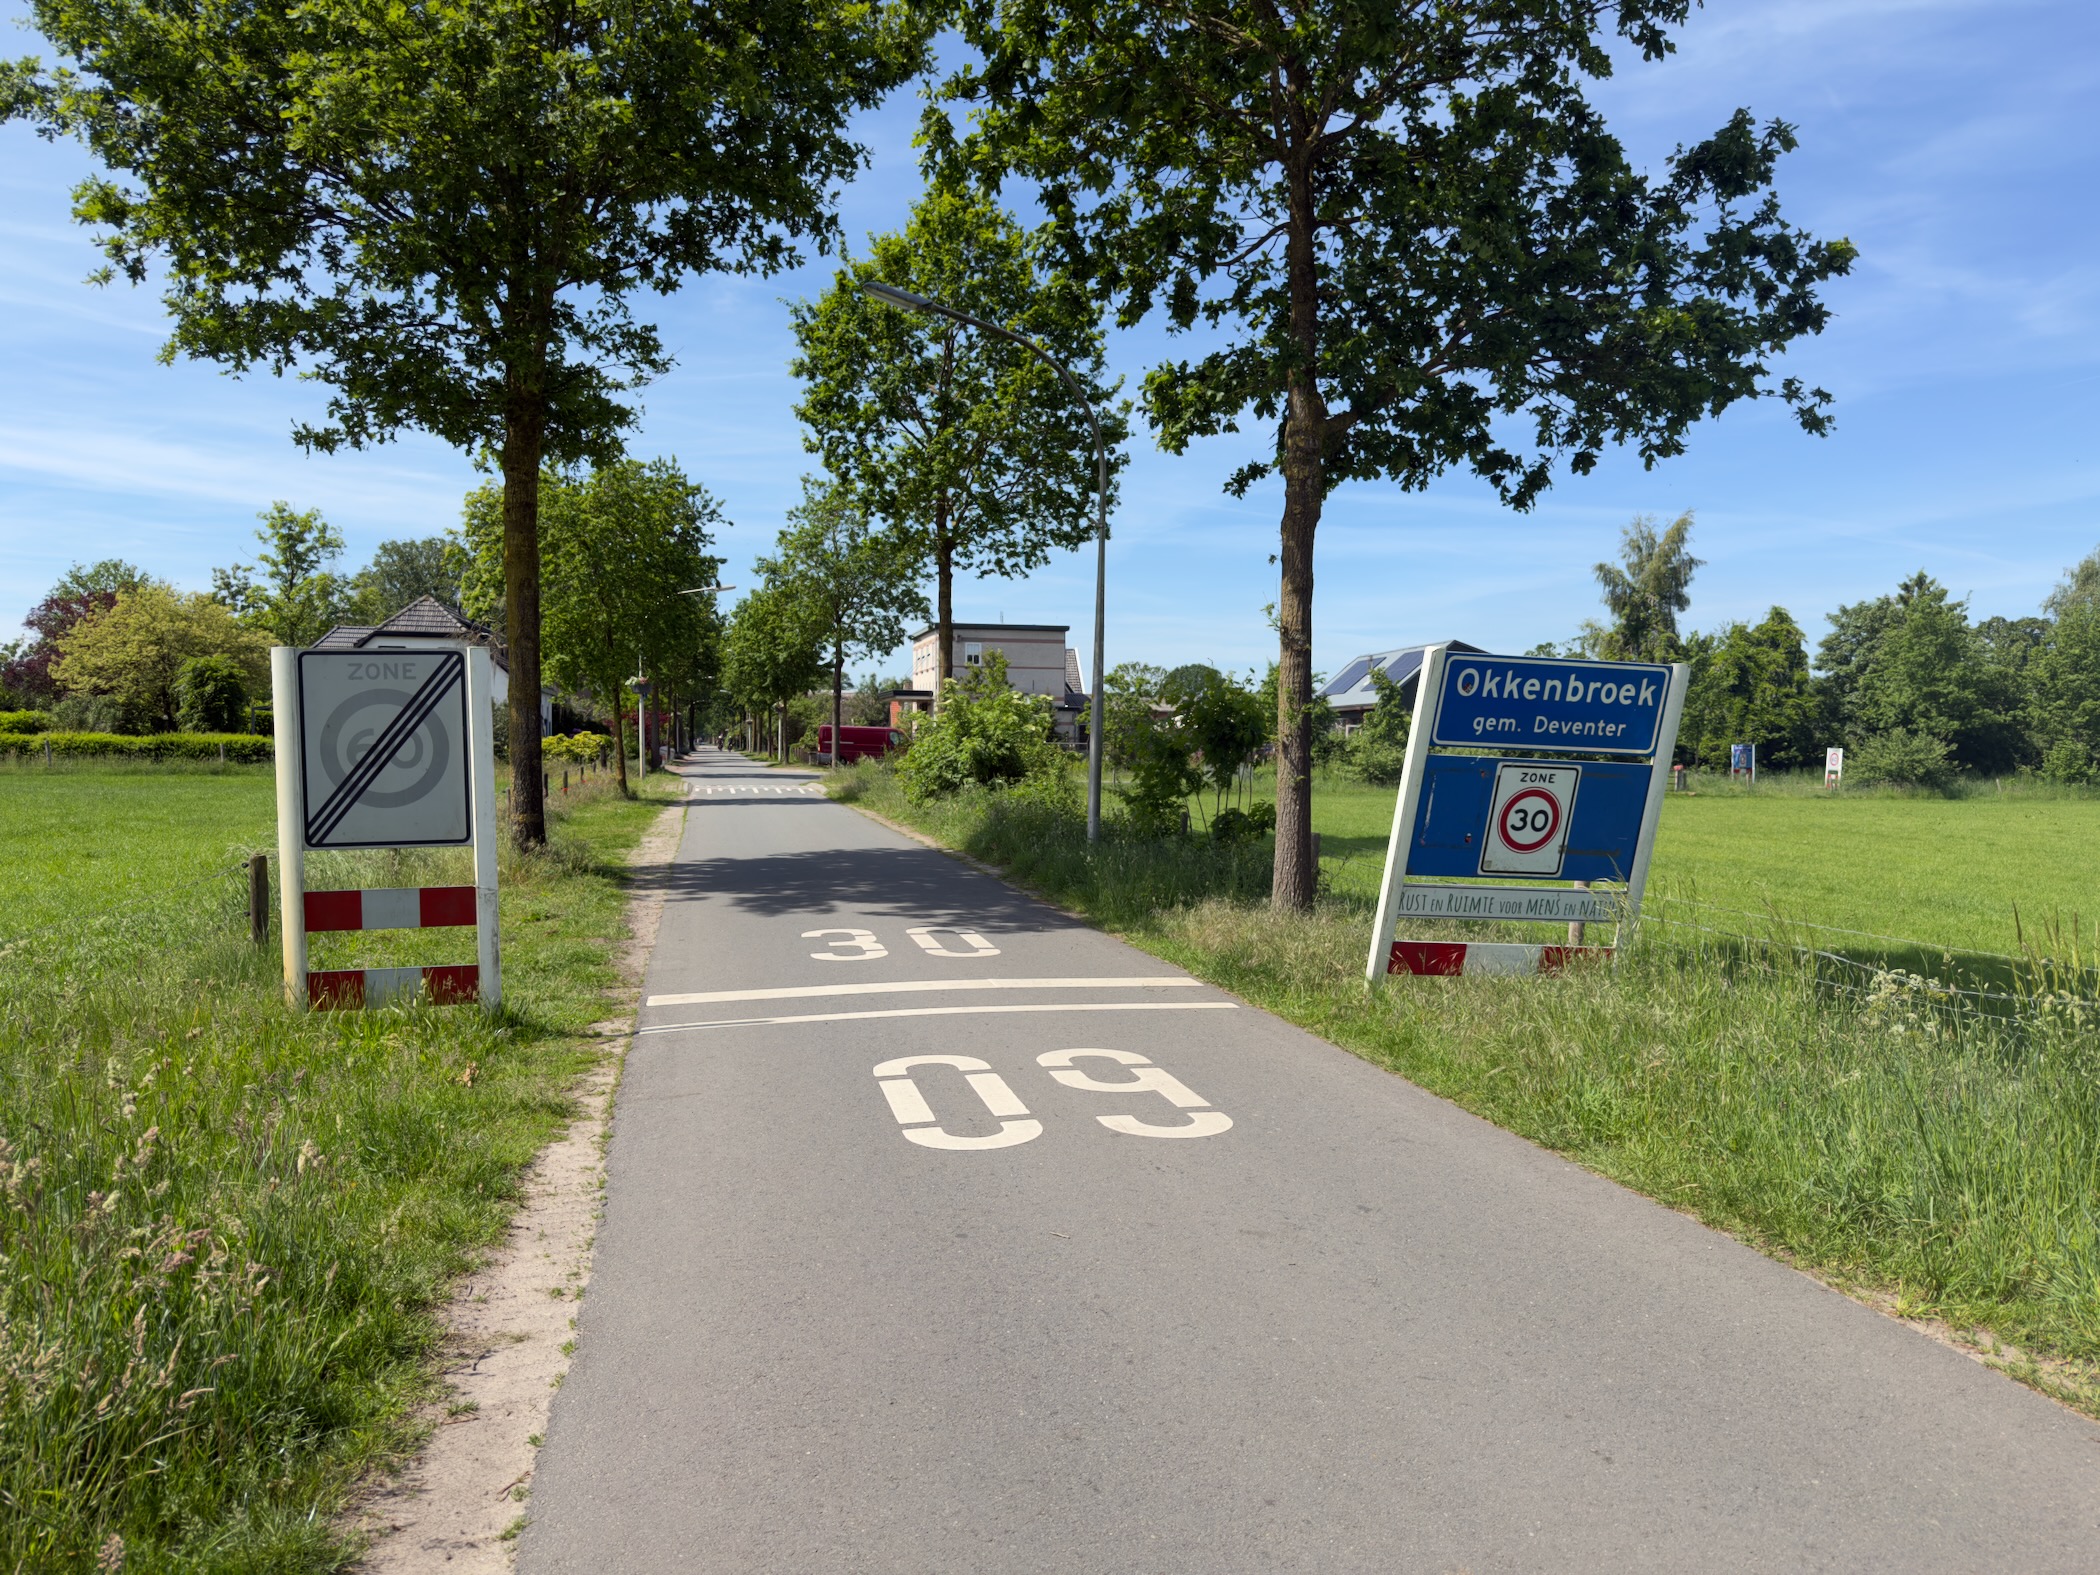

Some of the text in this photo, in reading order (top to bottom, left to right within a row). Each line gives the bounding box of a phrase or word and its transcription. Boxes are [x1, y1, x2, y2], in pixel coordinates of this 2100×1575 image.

[347, 662, 417, 680] ZONE
[1456, 667, 1657, 706] Okkenbroek
[1472, 715, 1627, 737] gem. Deventer
[346, 727, 424, 771] 60
[1520, 772, 1557, 784] ZONE
[1510, 808, 1549, 832] 30
[1398, 891, 1428, 911] RUST
[1446, 893, 1495, 914] RUIMTE
[1525, 897, 1560, 916] MENS
[801, 926, 1001, 961] 30
